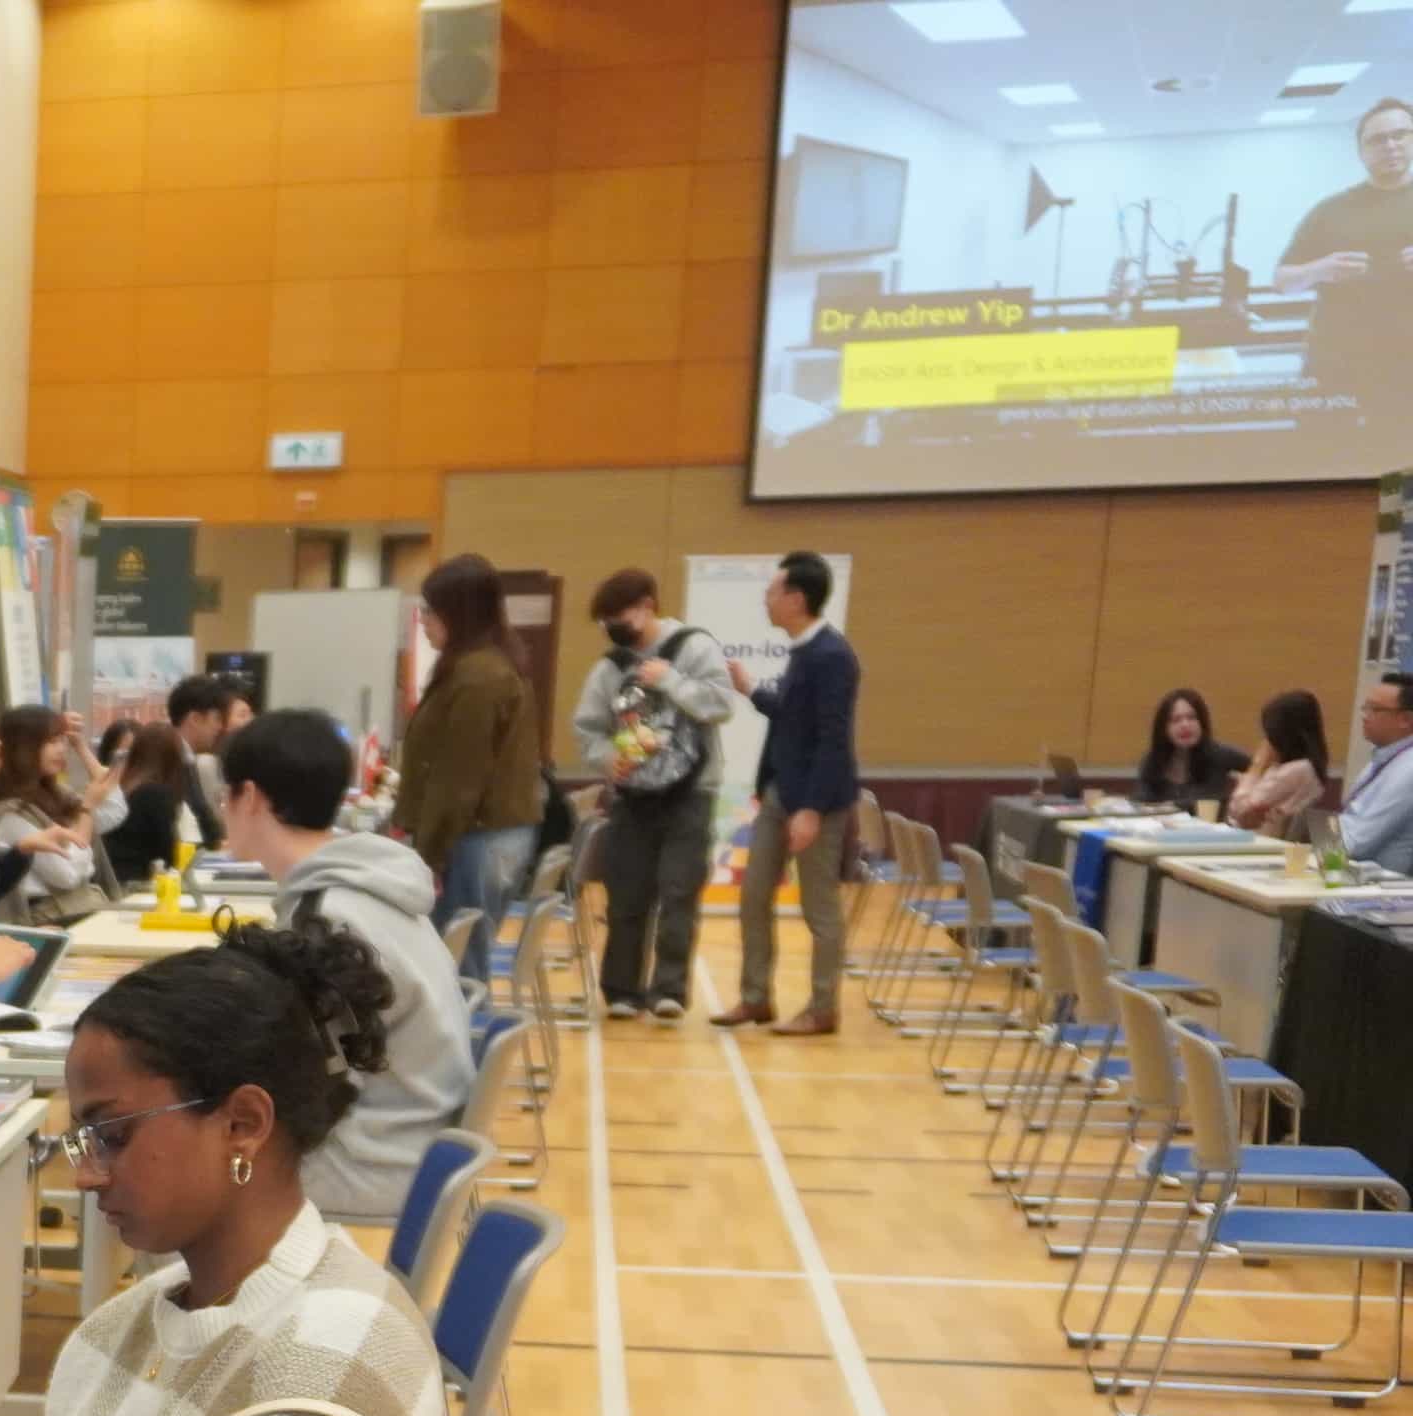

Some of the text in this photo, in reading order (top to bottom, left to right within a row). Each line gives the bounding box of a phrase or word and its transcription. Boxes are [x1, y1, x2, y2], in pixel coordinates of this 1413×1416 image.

[820, 299, 1023, 332] Dr Andrew Yip
